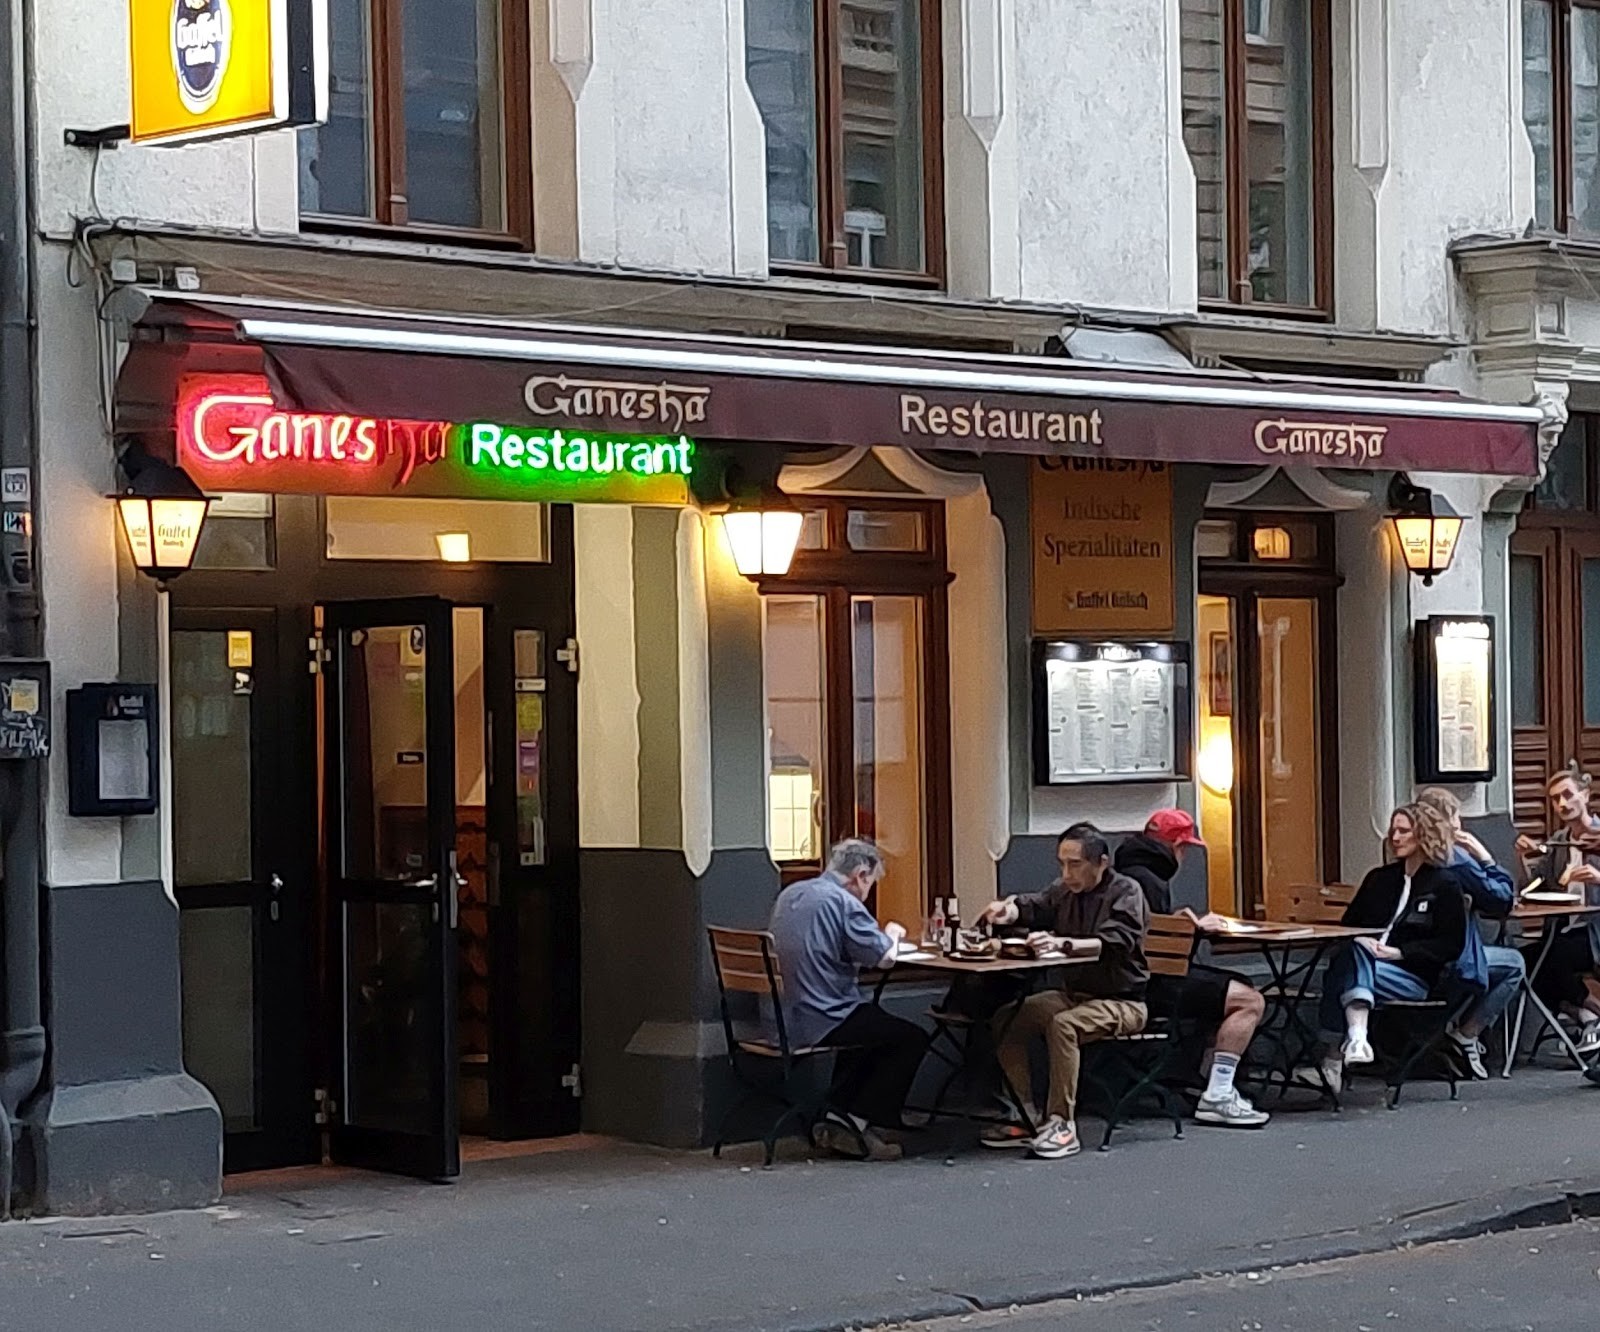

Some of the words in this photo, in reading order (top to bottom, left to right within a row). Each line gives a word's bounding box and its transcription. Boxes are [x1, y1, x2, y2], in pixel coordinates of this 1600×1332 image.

[524, 373, 711, 433] Ganesha
[900, 394, 1103, 445] Restaurant
[471, 422, 693, 475] Restaurant
[1254, 417, 1389, 466] Ganesha
[1064, 498, 1142, 521] Indische
[1044, 533, 1161, 565] Spezialitäten
